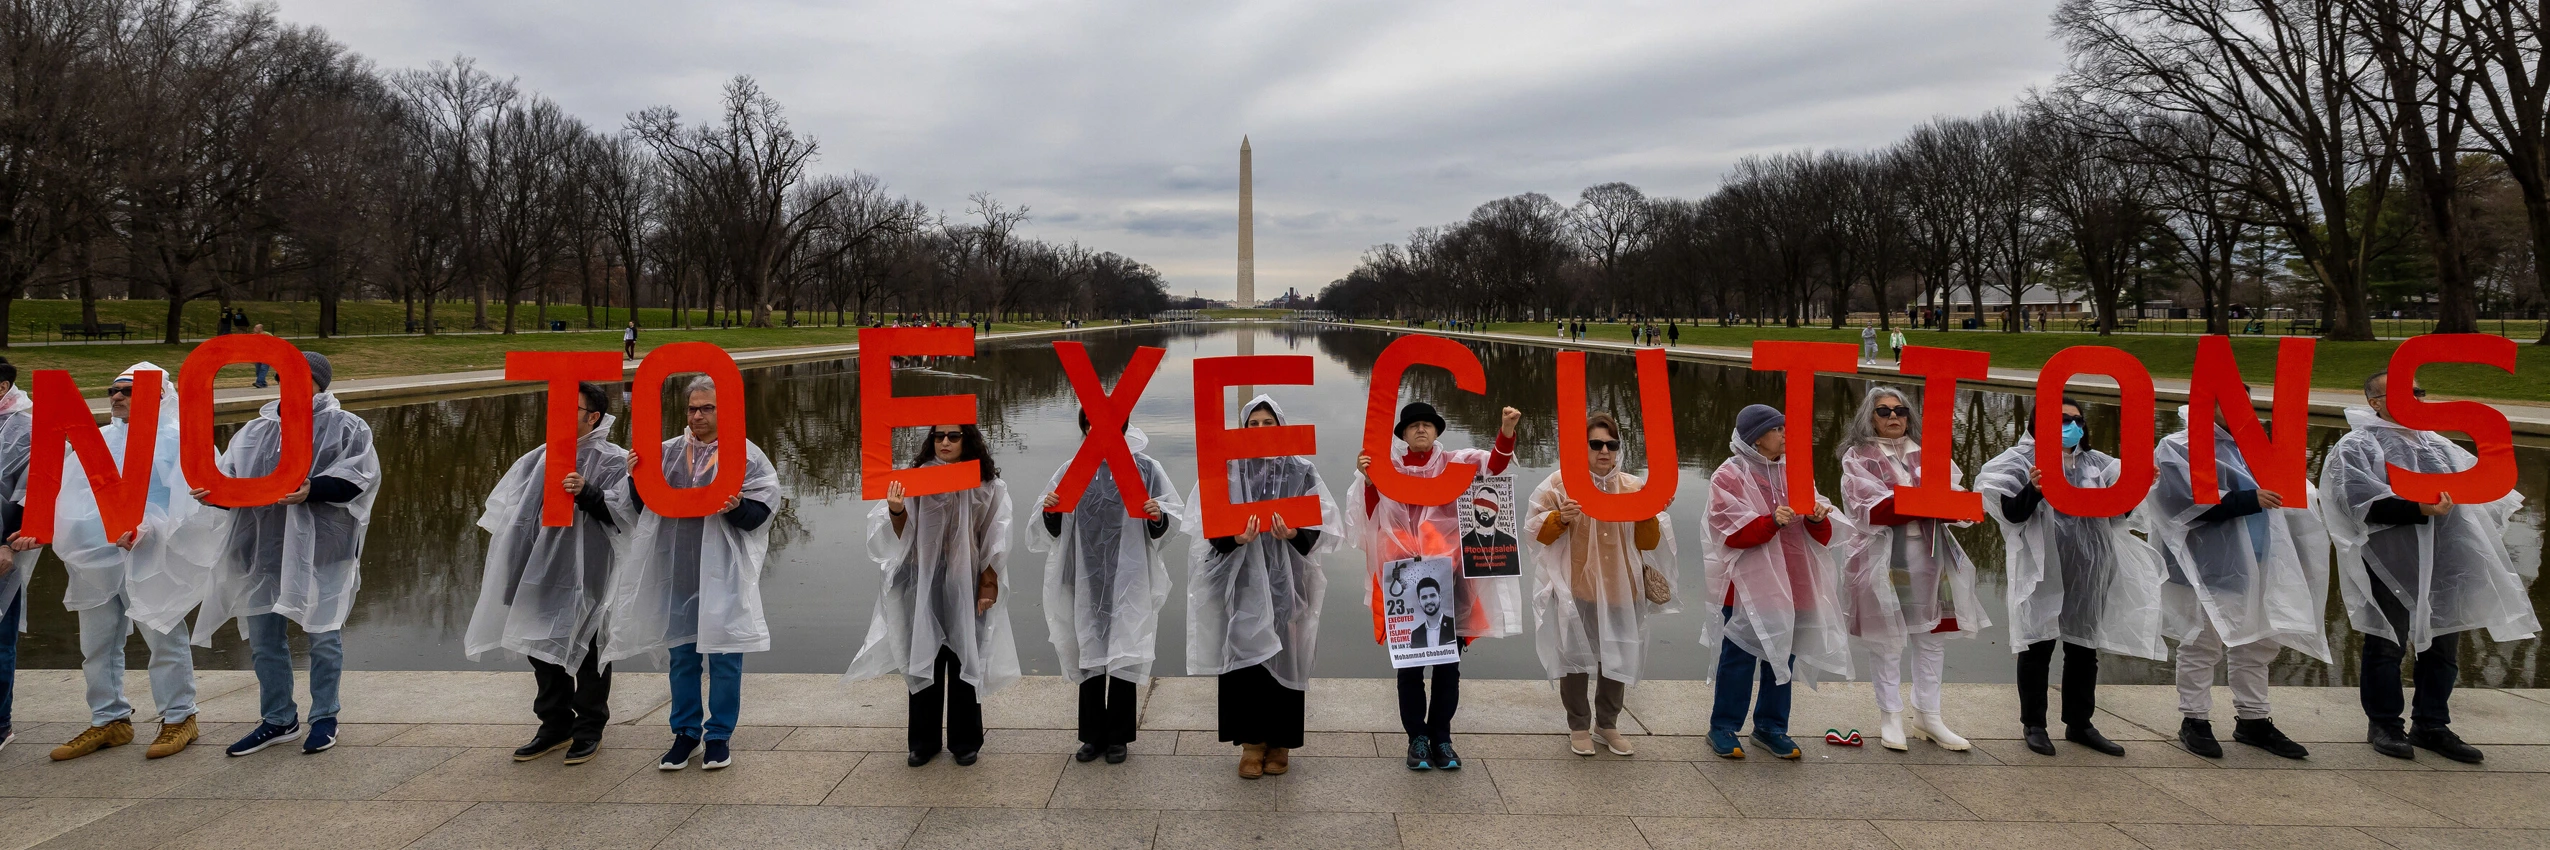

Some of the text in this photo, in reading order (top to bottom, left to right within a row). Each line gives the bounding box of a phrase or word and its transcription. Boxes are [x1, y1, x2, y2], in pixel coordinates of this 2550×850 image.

[20, 327, 2518, 544] NO TO EXECUTIONS
[1387, 599, 1405, 615] 23
[1388, 615, 1414, 623] EXECUTED
[1390, 629, 1411, 637] ISLAMIC
[1394, 651, 1426, 660] Mohammad
